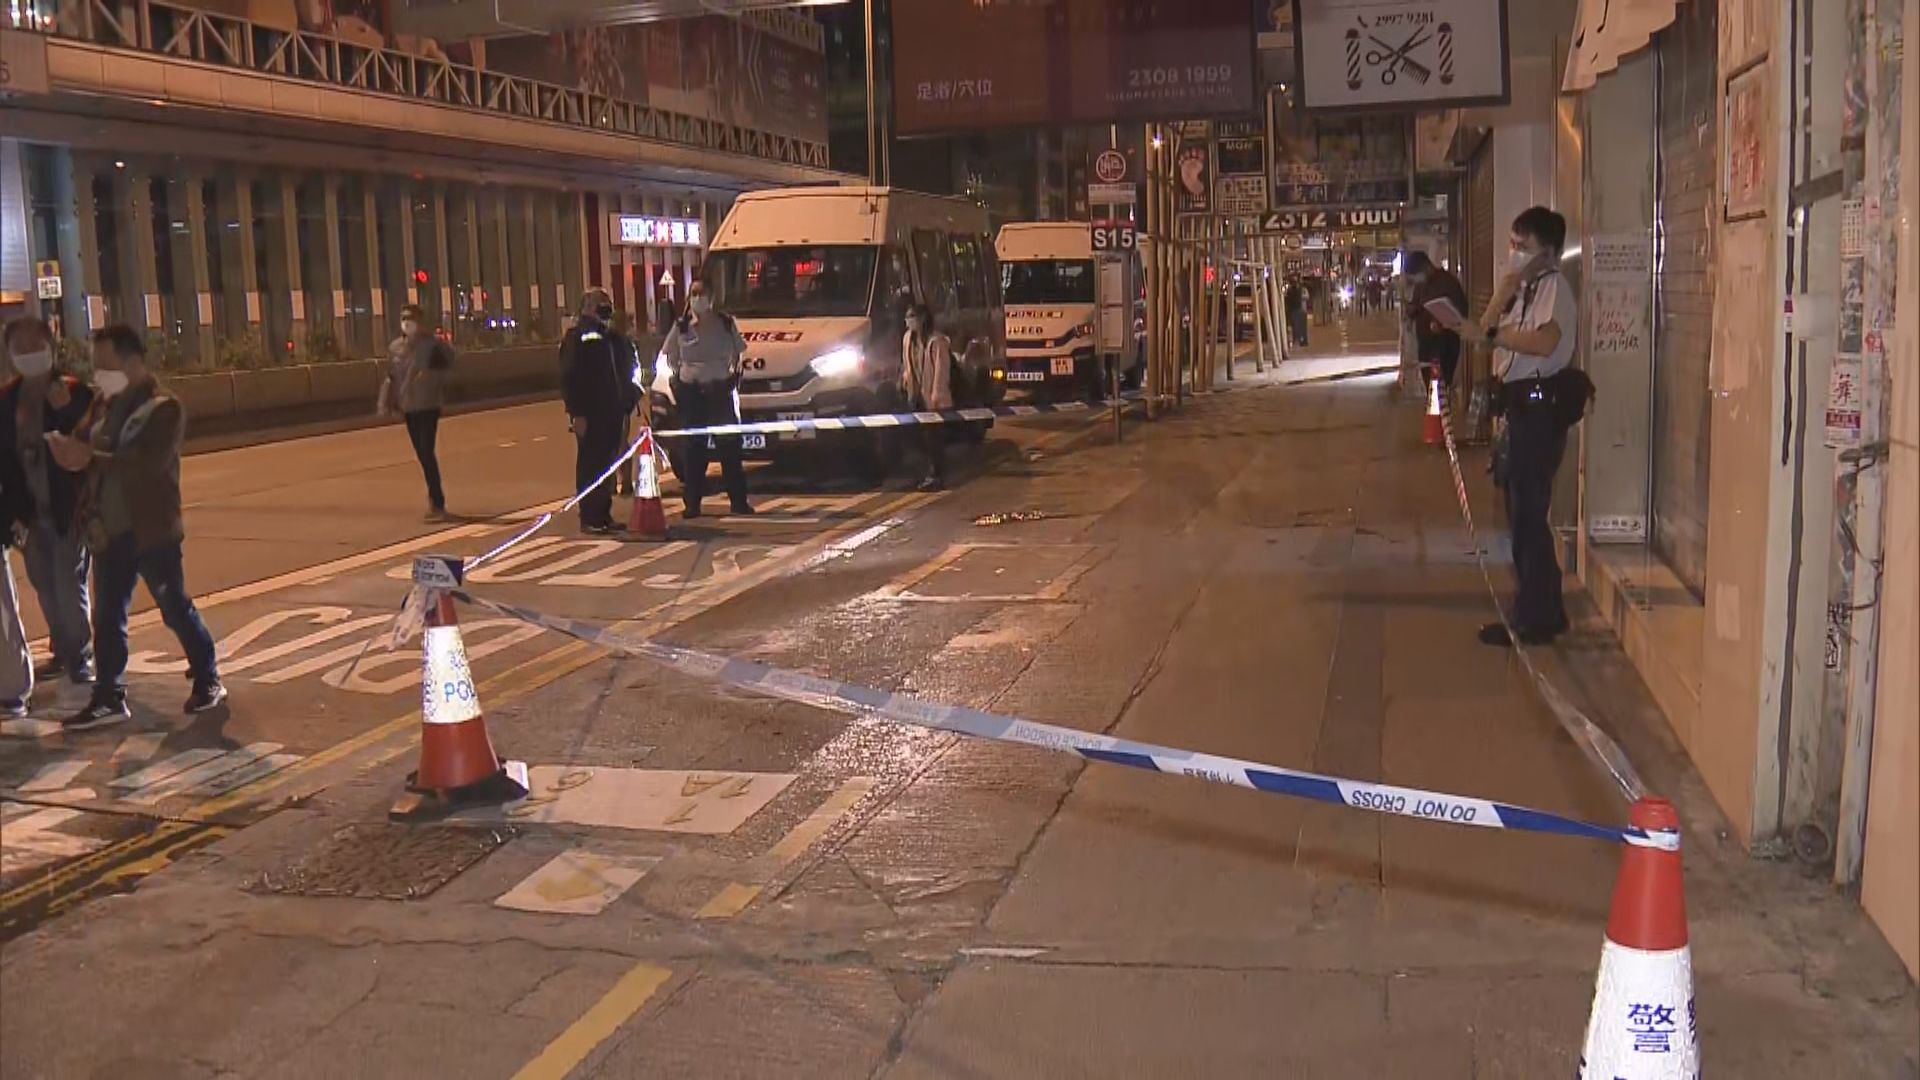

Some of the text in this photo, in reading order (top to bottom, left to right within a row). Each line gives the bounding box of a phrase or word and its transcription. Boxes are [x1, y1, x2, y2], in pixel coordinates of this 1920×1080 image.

[1375, 14, 1404, 27] 2997
[1129, 63, 1232, 87] 2308 1999
[1094, 227, 1133, 248] S15
[1351, 789, 1477, 822] DO NOT CROSS
